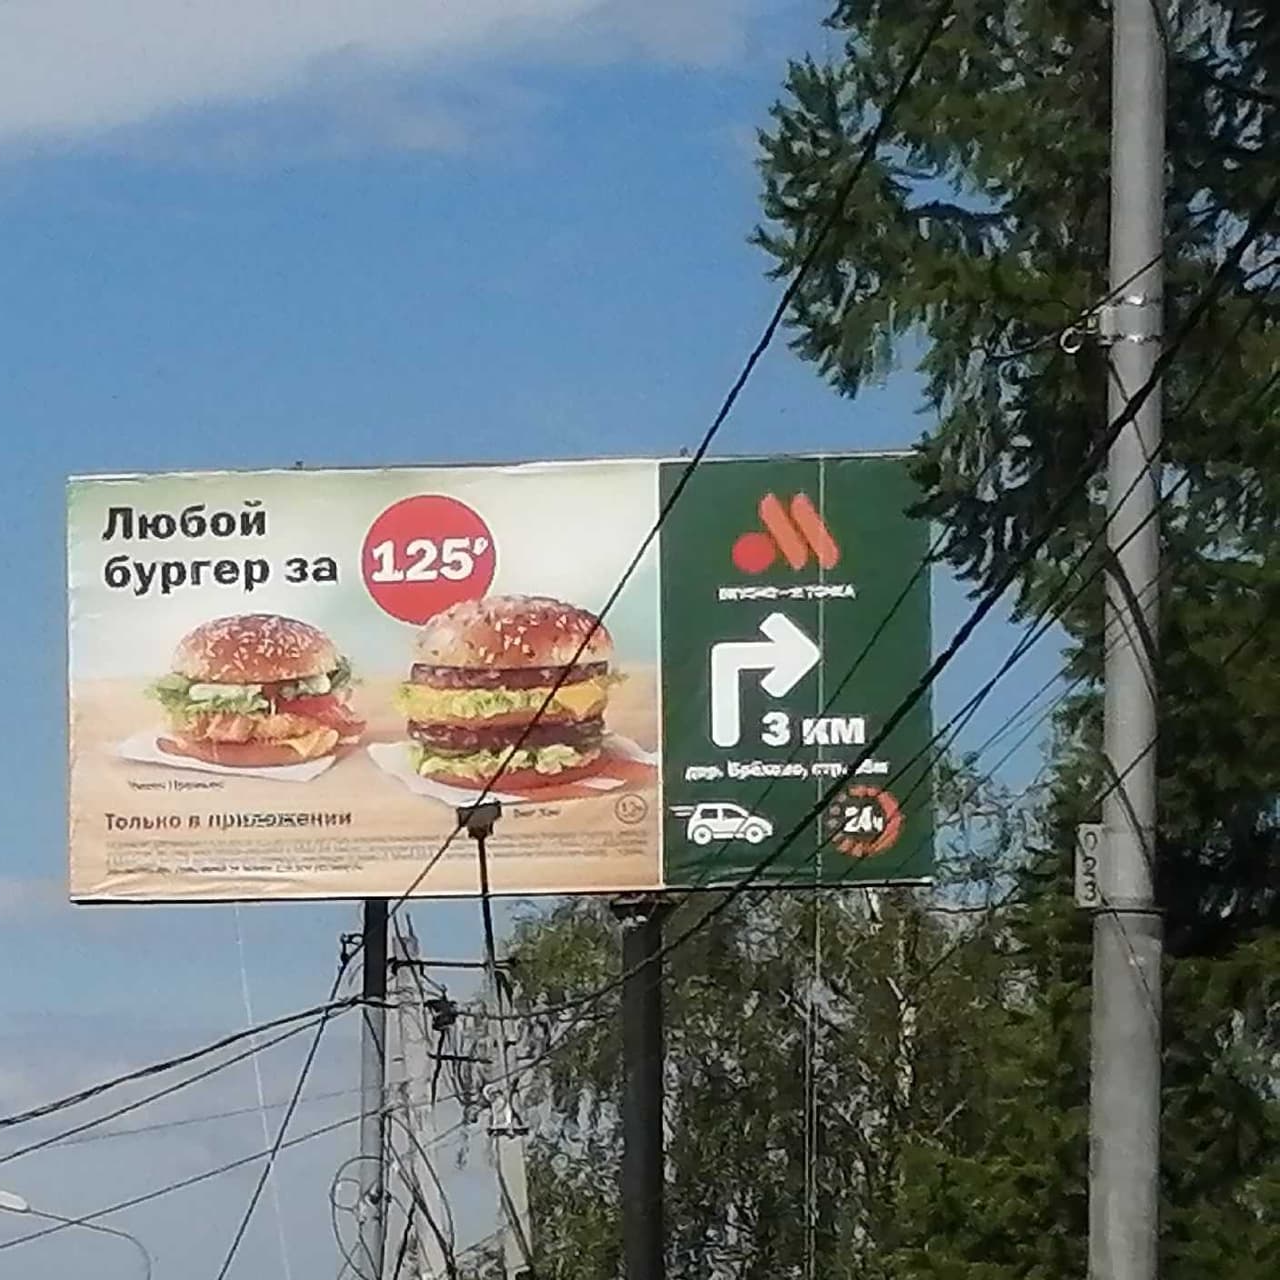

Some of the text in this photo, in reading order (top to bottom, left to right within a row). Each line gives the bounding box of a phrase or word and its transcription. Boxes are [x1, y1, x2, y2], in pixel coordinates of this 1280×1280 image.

[101, 499, 267, 541] Любой
[103, 554, 339, 596] бургер за
[761, 710, 791, 747] 3
[104, 810, 353, 832] Только в приложении
